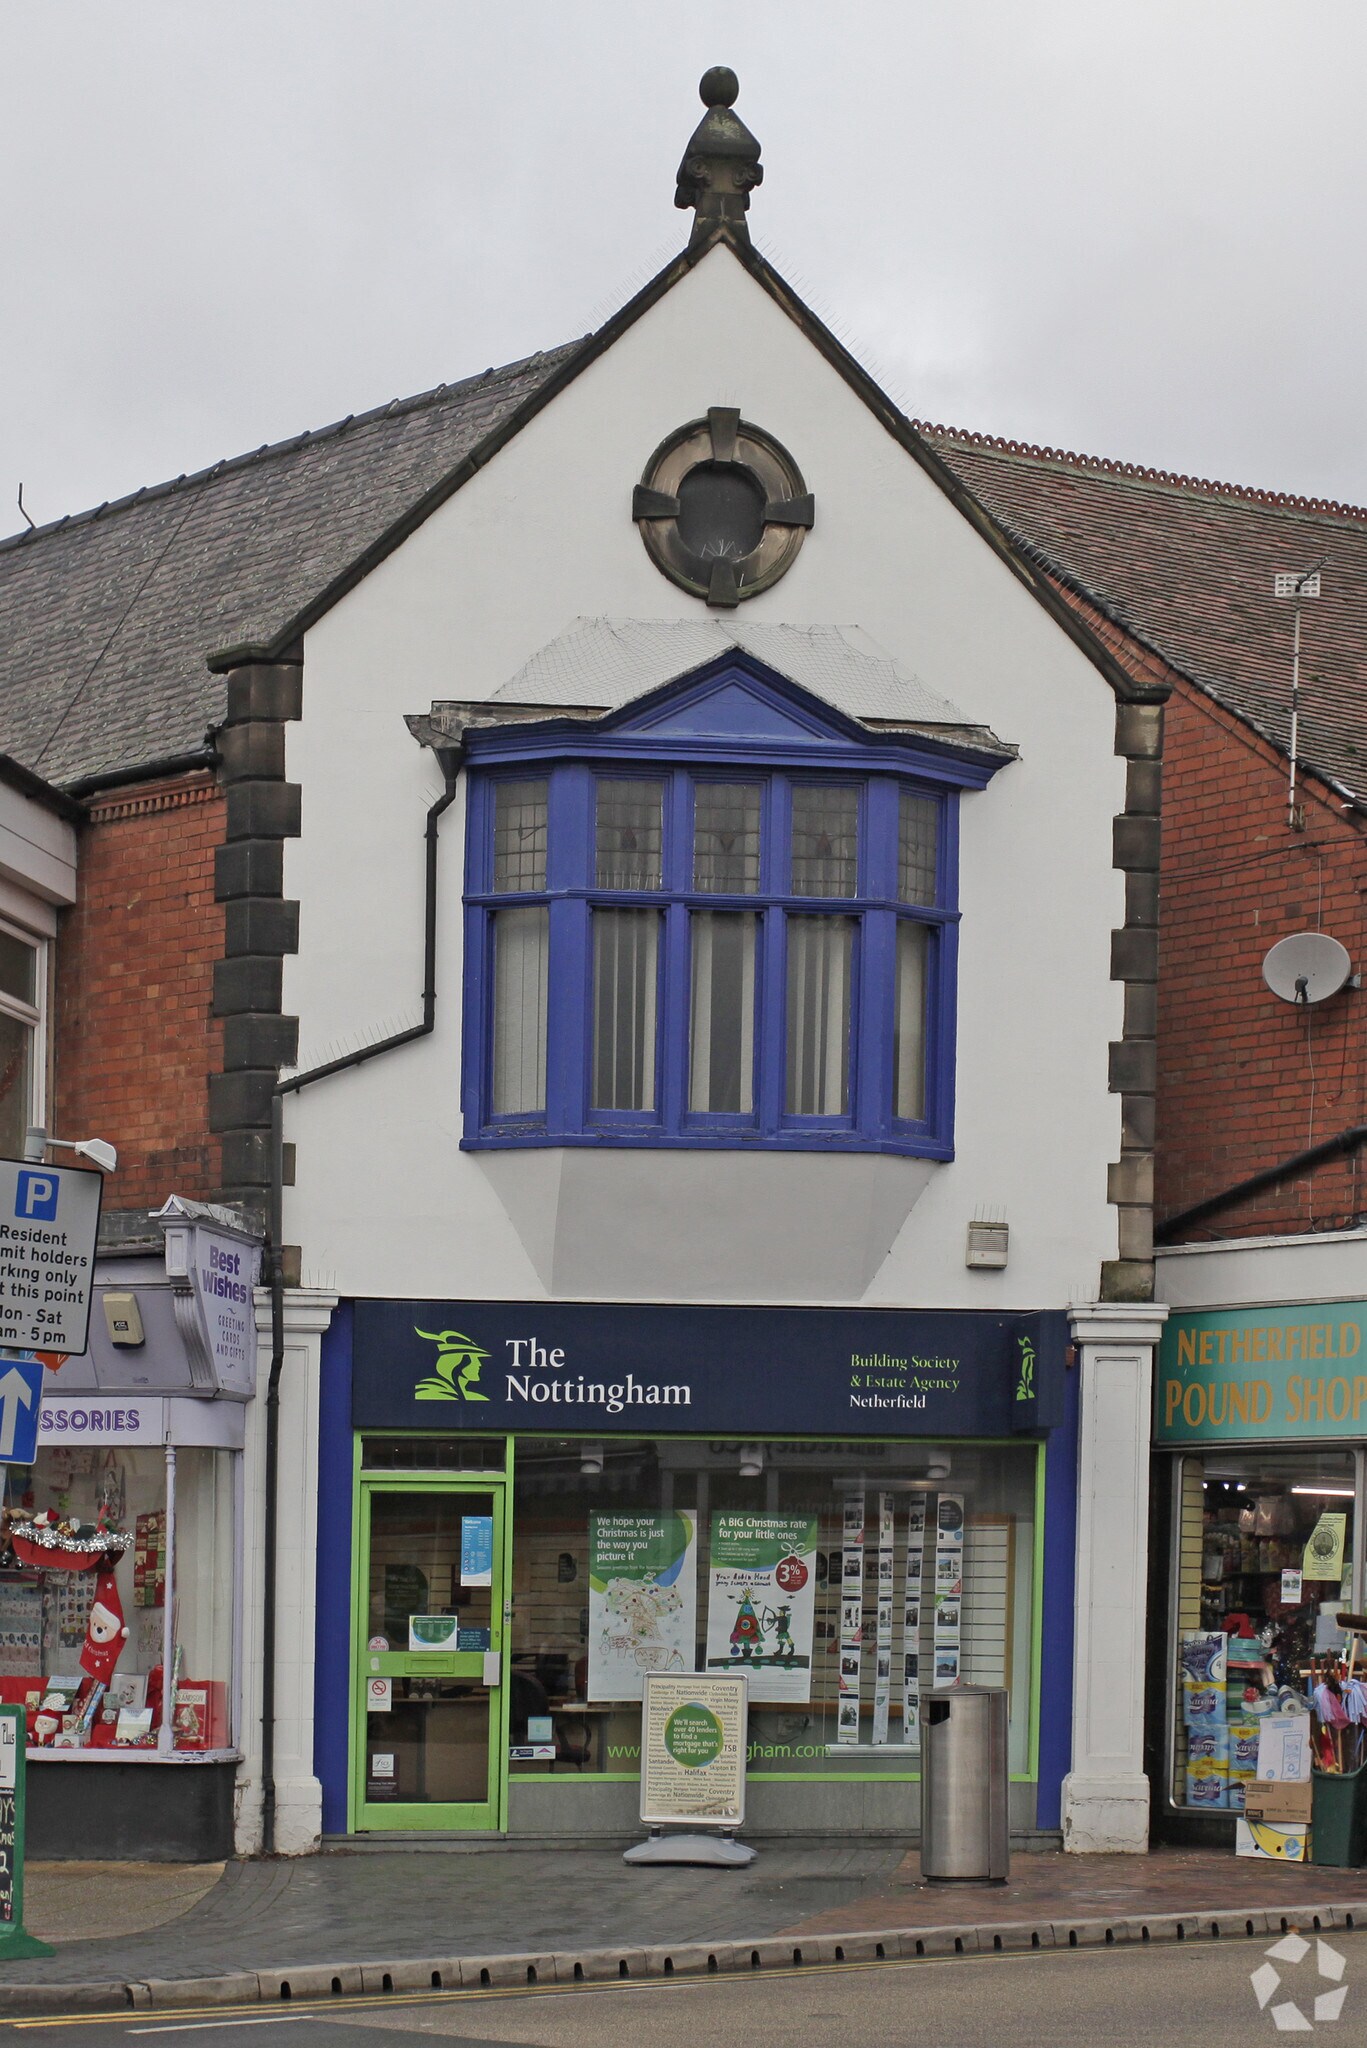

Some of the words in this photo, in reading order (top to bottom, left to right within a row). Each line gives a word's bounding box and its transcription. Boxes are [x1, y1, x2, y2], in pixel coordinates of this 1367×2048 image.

[25, 1177, 52, 1214] P
[0, 1224, 67, 1246] Resident
[31, 1247, 88, 1267] holders
[210, 1244, 240, 1276] Best
[45, 1270, 77, 1286] only
[202, 1269, 247, 1304] Wishes
[11, 1283, 39, 1299] this
[45, 1289, 83, 1304] point
[36, 1309, 62, 1325] Sat
[218, 1315, 245, 1332] GREETING
[31, 1327, 40, 1341] 5
[44, 1331, 66, 1344] pm
[222, 1331, 240, 1345] CARDS
[1177, 1322, 1361, 1366] NETHERFIELD
[216, 1343, 228, 1356] AND
[229, 1346, 245, 1361] GIFTS
[505, 1337, 565, 1368] The
[851, 1354, 907, 1371] Building
[911, 1355, 960, 1372] Society
[850, 1374, 861, 1387] &
[866, 1375, 906, 1387] Estate
[910, 1376, 960, 1393] Agency
[505, 1373, 691, 1413] Nottingham
[850, 1394, 926, 1408] Netherfield
[1165, 1379, 1273, 1427] POUND
[1285, 1375, 1367, 1423] SHOP
[597, 1517, 611, 1526] We
[613, 1517, 634, 1528] hope
[636, 1519, 655, 1528] your
[719, 1518, 726, 1526] A
[728, 1518, 744, 1527] BIG
[746, 1518, 788, 1528] Christmas
[790, 1520, 807, 1529] rate
[597, 1528, 638, 1537] Christmas
[640, 1529, 647, 1537] is
[648, 1529, 664, 1540] just
[719, 1528, 731, 1538] for
[734, 1531, 753, 1540] your
[755, 1529, 775, 1539] little
[778, 1532, 797, 1540] ones
[597, 1540, 611, 1549] the
[613, 1542, 630, 1551] way
[633, 1542, 648, 1551] you
[597, 1552, 626, 1562] picture
[628, 1551, 634, 1560] it
[780, 1564, 800, 1583] 3%
[709, 1788, 735, 1796] Coventry
